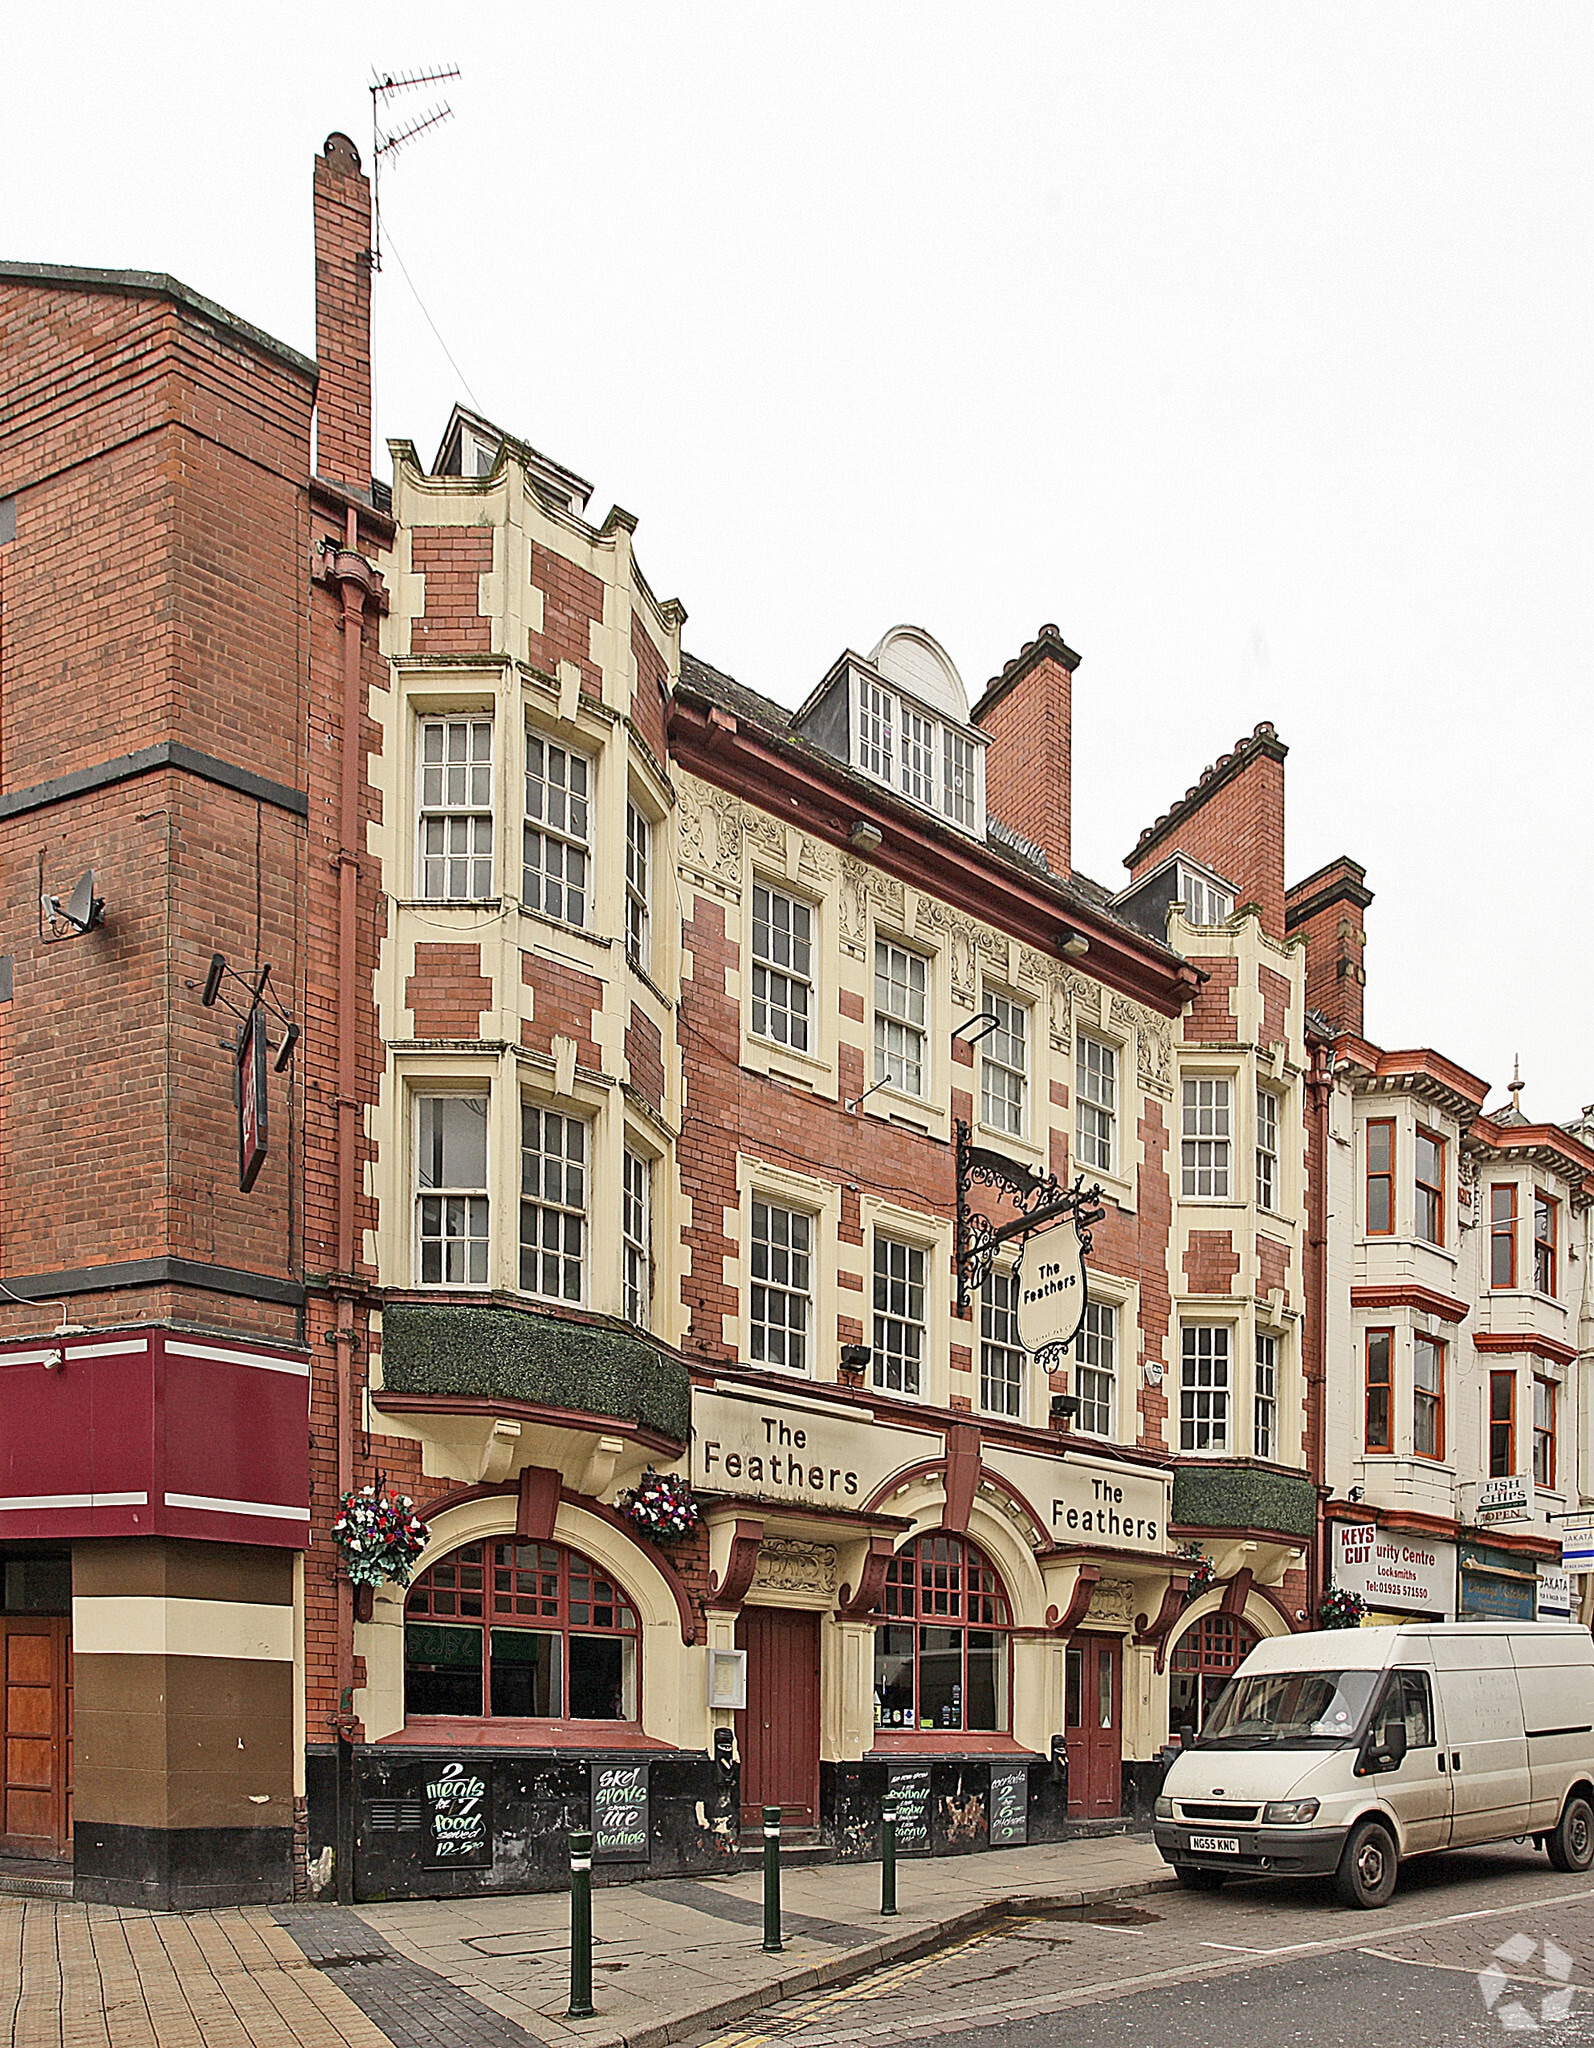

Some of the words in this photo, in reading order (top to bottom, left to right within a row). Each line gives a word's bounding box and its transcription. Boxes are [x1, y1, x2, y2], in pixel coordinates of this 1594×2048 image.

[1038, 1263, 1060, 1279] The
[1023, 1275, 1076, 1304] Feathers
[761, 1417, 807, 1449] The
[705, 1440, 858, 1495] Feathers
[1091, 1478, 1123, 1504] The
[1486, 1480, 1520, 1492] FISH
[1480, 1490, 1526, 1504] CHIPS
[1052, 1499, 1157, 1541] Feathers
[1485, 1509, 1520, 1521] OPEN
[1341, 1526, 1374, 1546] KEYS
[1564, 1533, 1593, 1543] JAKATA
[1345, 1546, 1371, 1565] CUT
[1376, 1544, 1399, 1564] urity
[1402, 1547, 1436, 1567] Centre
[1377, 1565, 1417, 1581] Locksmiths
[1402, 1585, 1428, 1599] 571550
[439, 1763, 470, 1783] 2
[426, 1776, 486, 1799] meals
[997, 1785, 1017, 1801] 2
[432, 1813, 482, 1833] food
[1193, 1837, 1216, 1850] NG55
[1217, 1839, 1235, 1851] KNC
